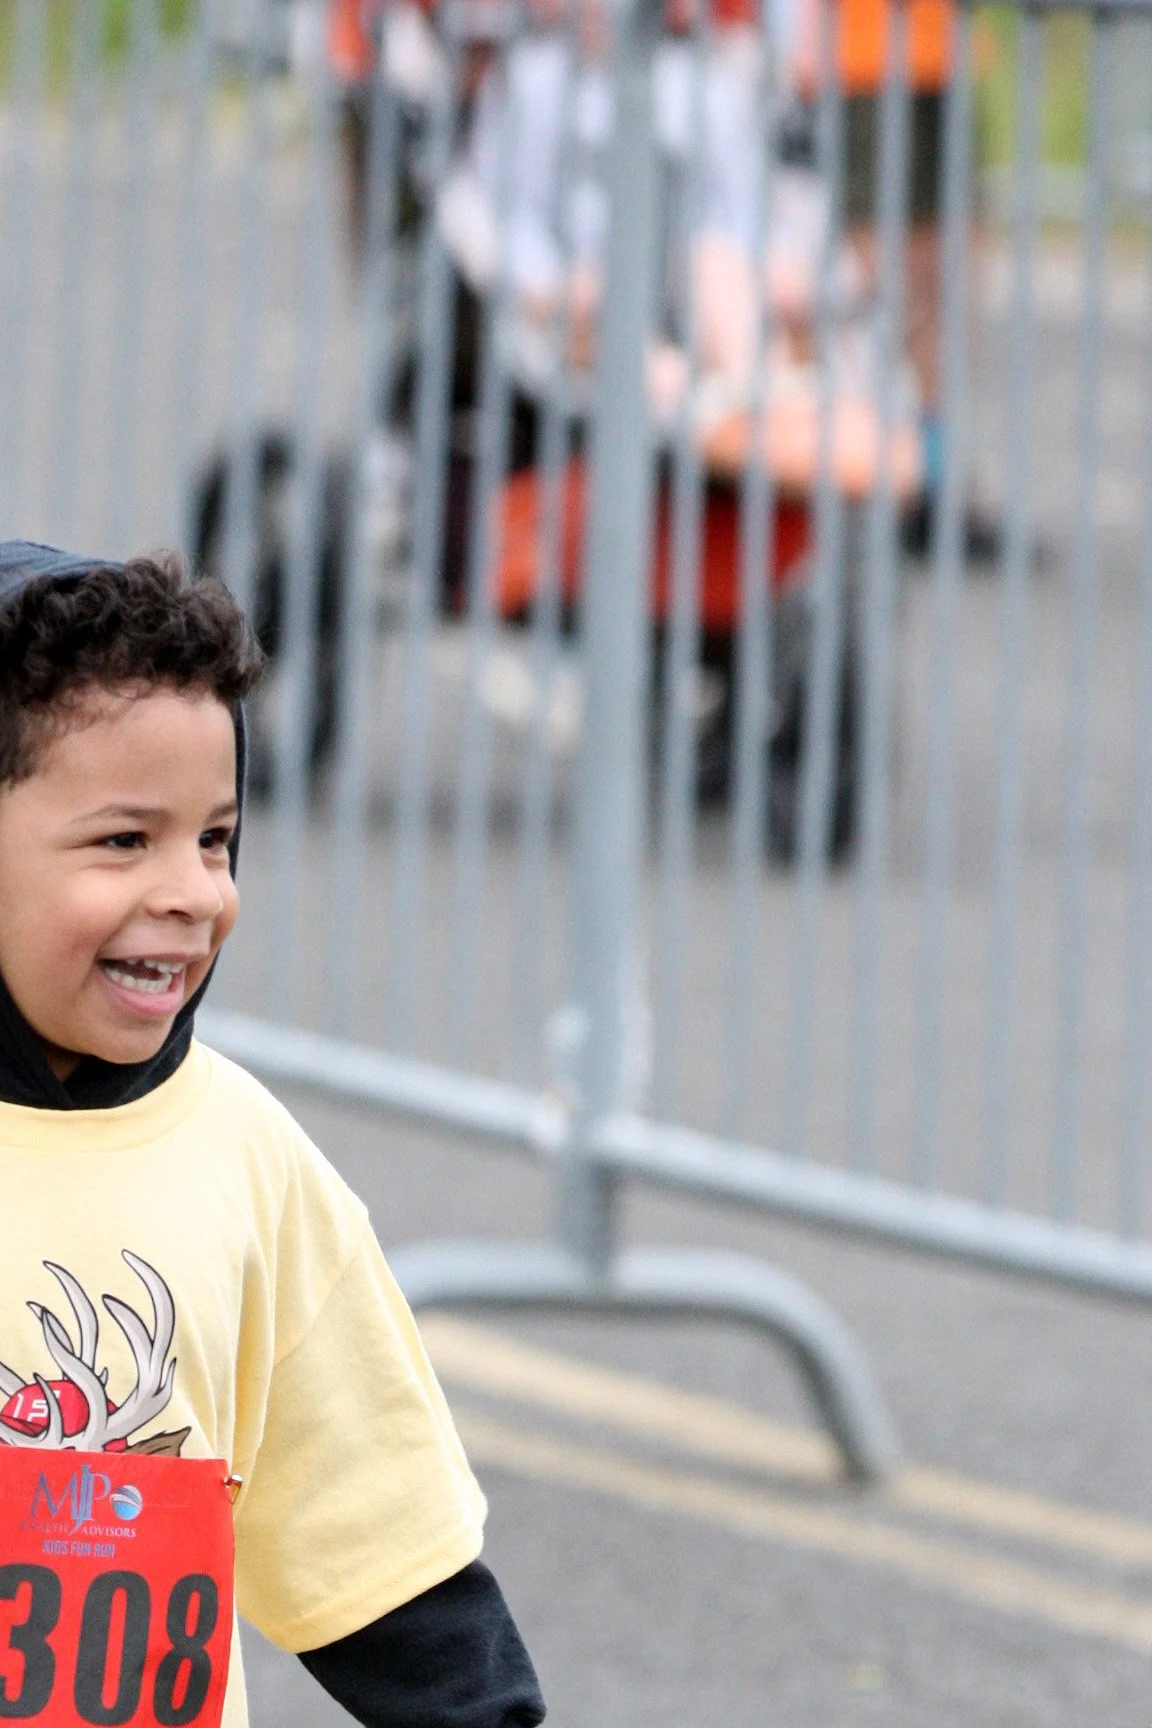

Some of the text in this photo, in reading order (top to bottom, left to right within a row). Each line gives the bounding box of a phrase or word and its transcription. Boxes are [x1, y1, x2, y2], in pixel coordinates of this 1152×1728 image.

[81, 1524, 136, 1538] ADVISORS
[42, 1539, 116, 1558] KIDS FUN RUN
